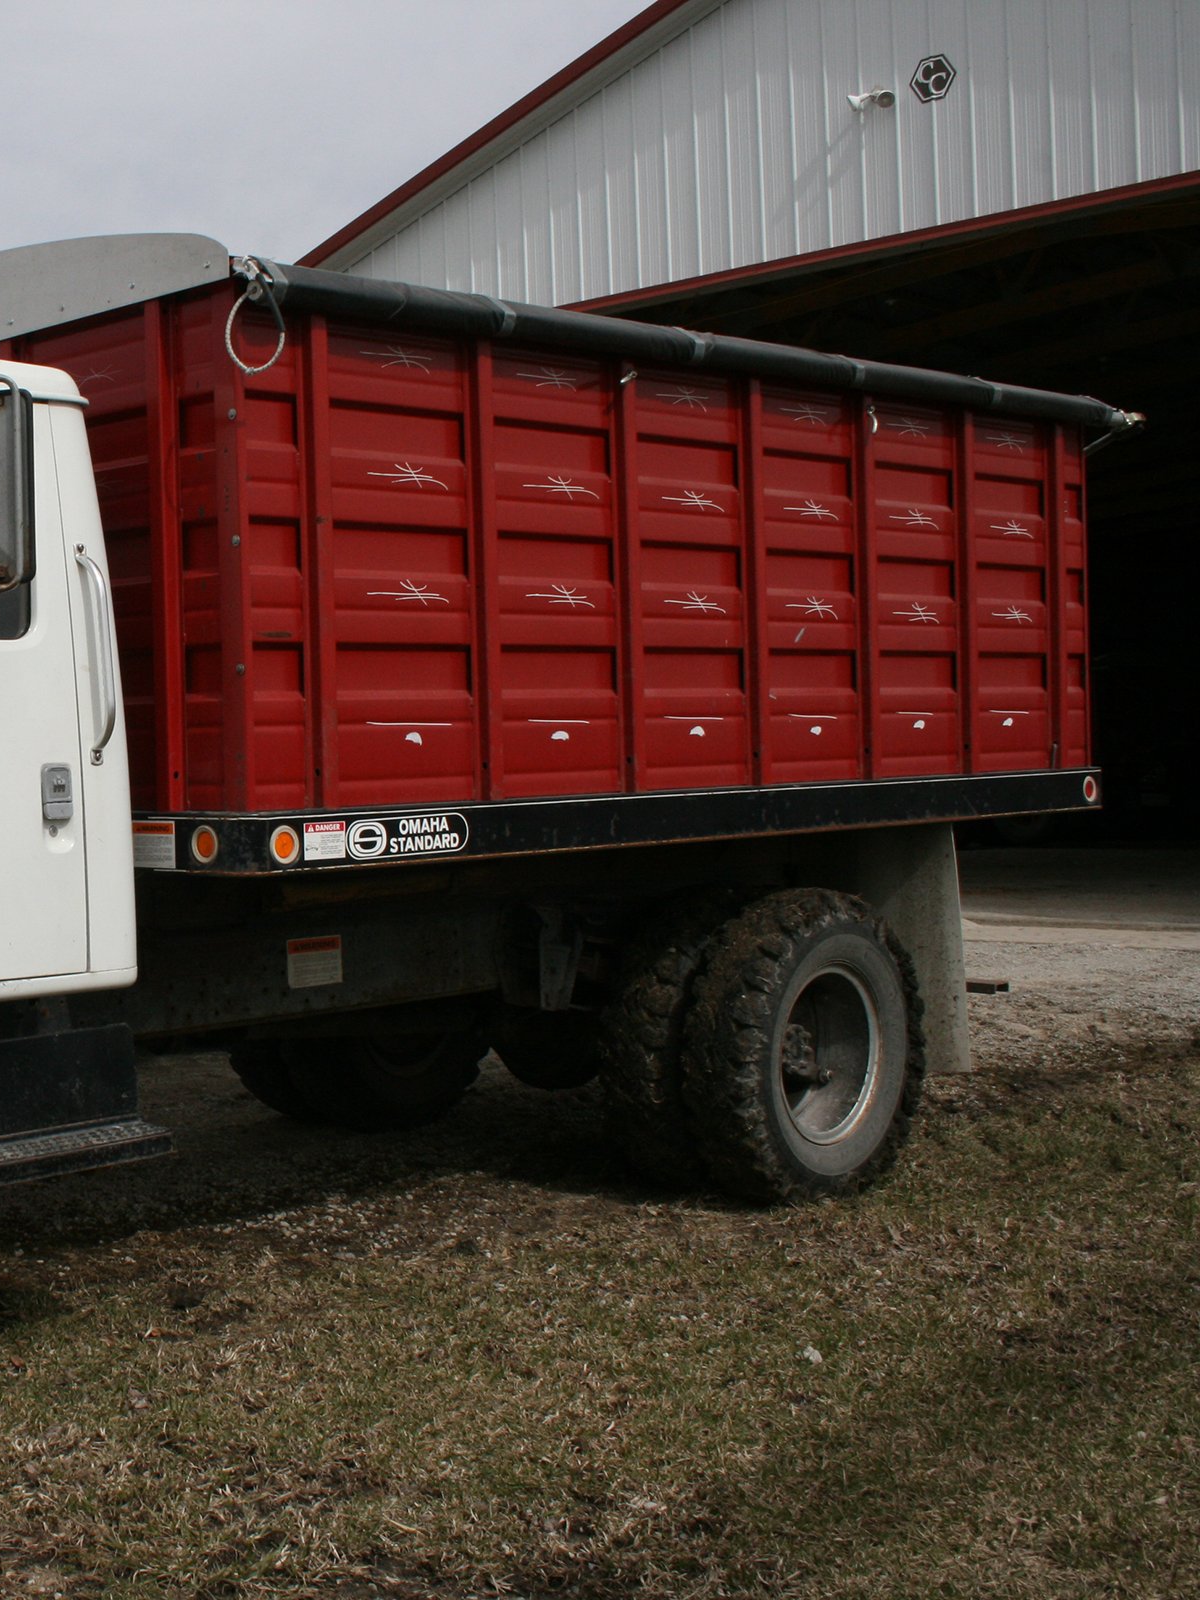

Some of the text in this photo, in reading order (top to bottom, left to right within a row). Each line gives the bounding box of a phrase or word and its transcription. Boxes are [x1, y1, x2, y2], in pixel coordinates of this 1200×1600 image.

[315, 823, 341, 832] DANGER
[398, 816, 450, 835] OMAHA
[389, 832, 460, 854] STANDARD
